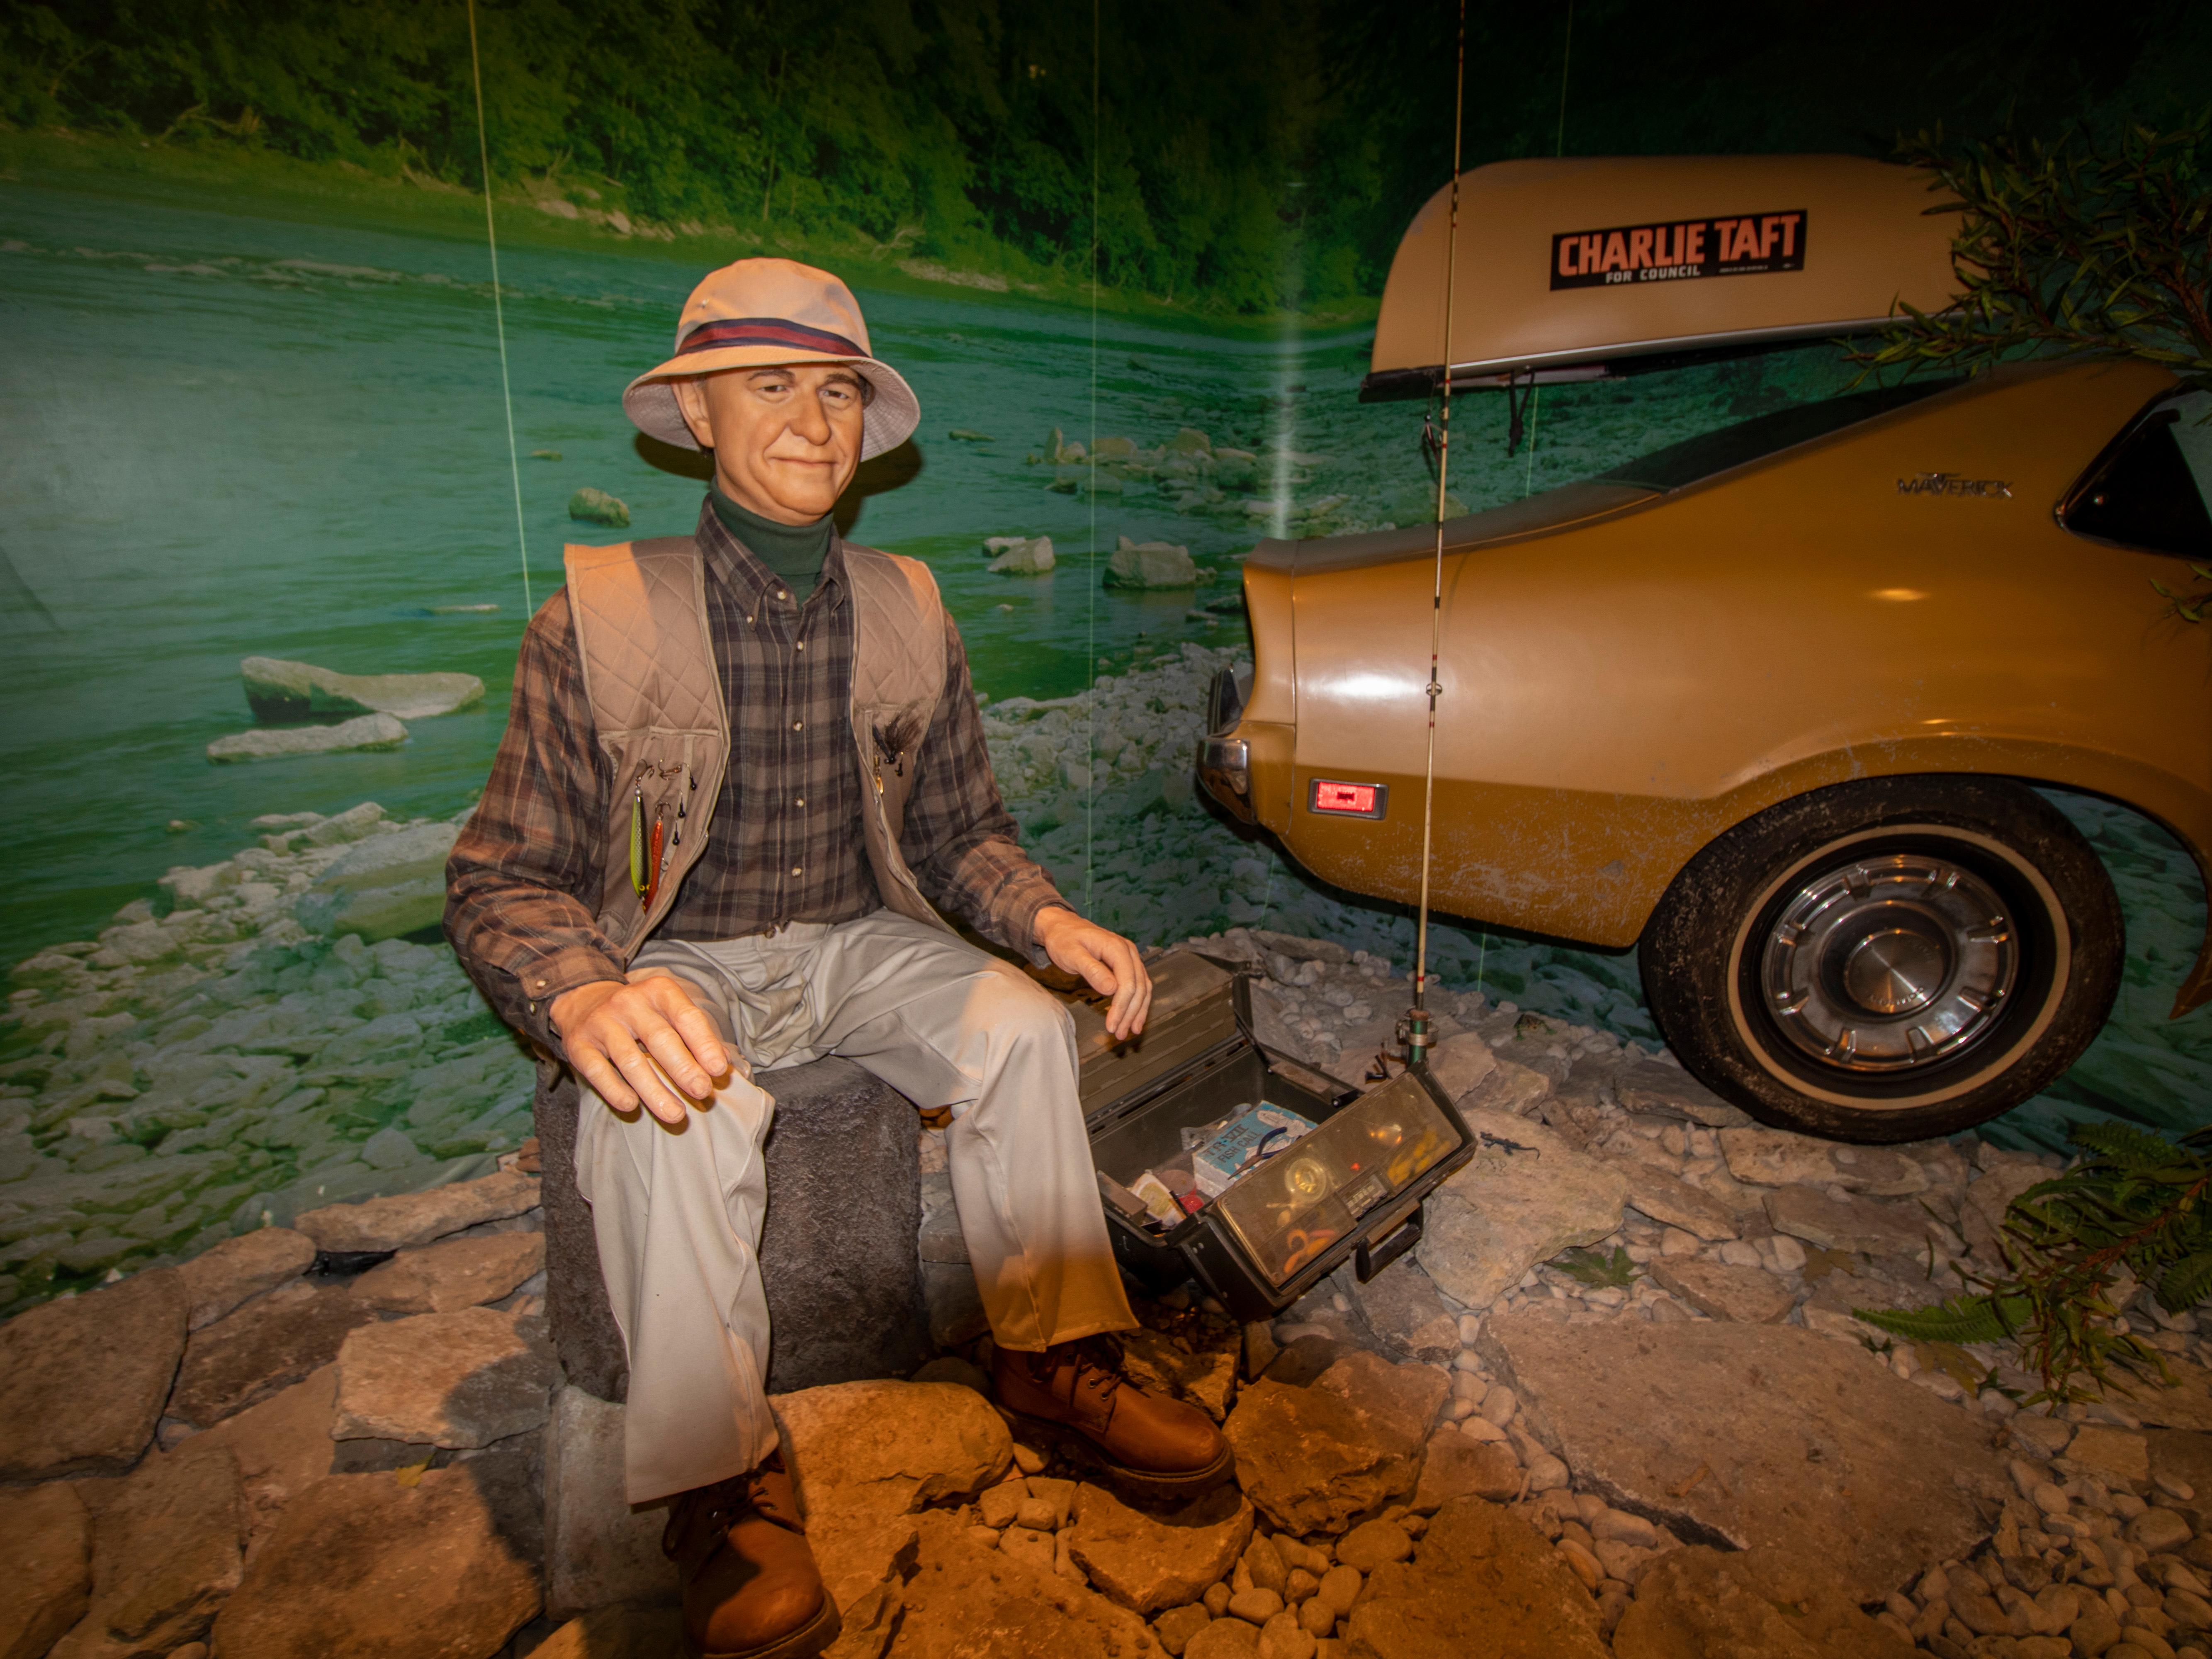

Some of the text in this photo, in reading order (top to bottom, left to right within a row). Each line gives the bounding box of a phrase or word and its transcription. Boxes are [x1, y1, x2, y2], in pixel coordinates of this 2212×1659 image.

[1558, 214, 1800, 277] CHARLIE TAFT
[1605, 265, 1700, 284] FOR COUNCIL
[1897, 477, 2014, 499] MAVERICK
[1217, 1131, 1262, 1163] FISH CALL
